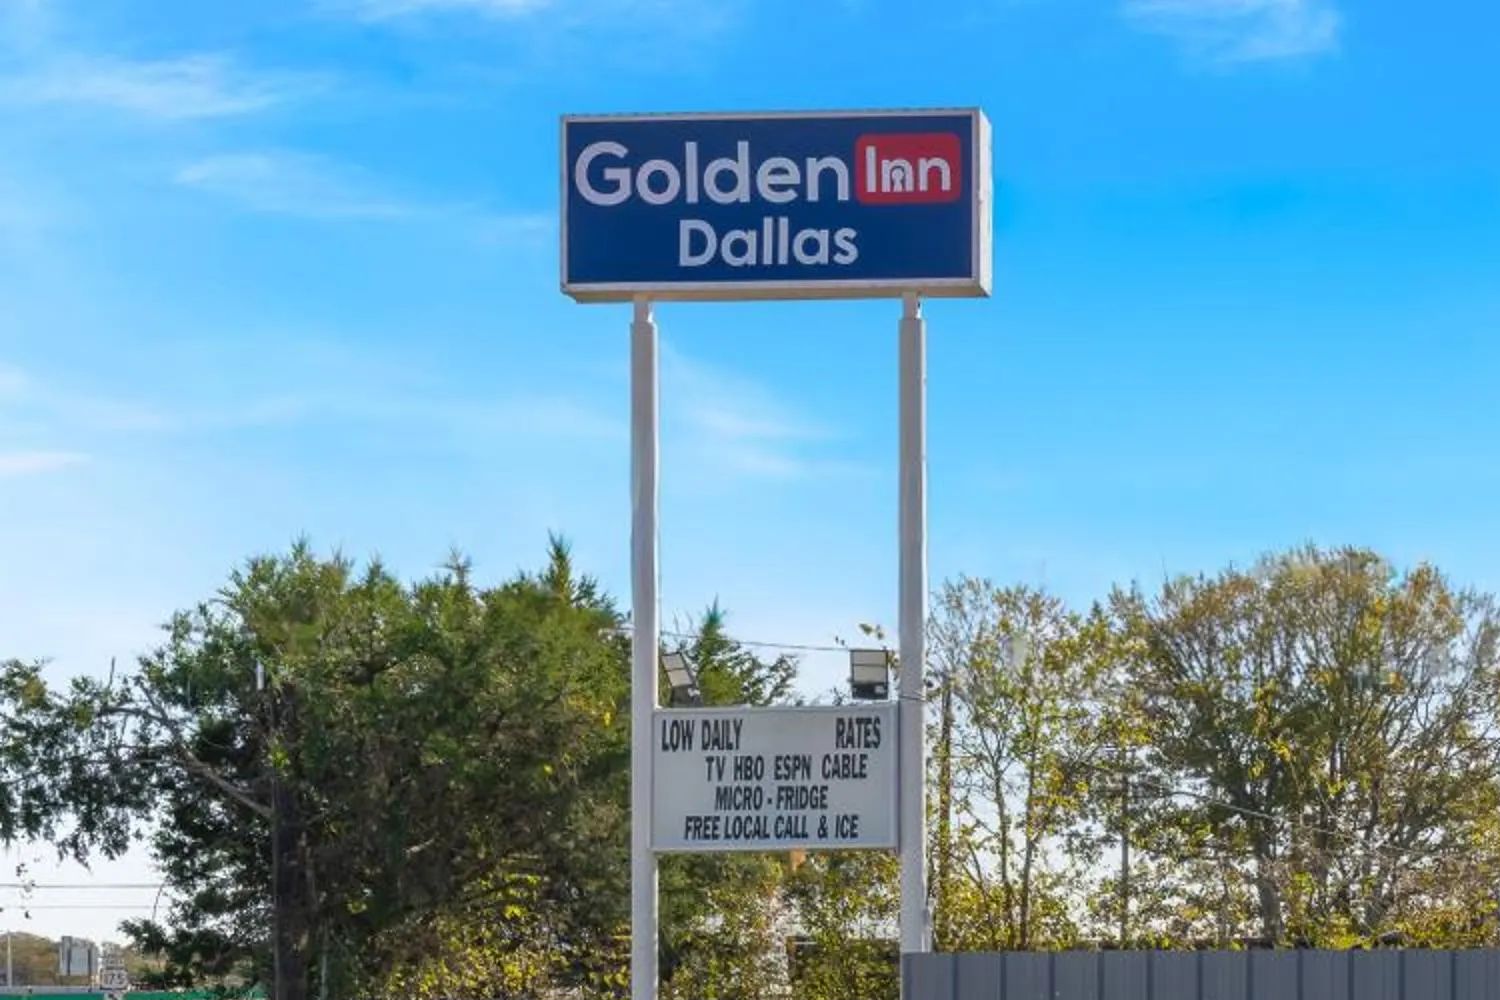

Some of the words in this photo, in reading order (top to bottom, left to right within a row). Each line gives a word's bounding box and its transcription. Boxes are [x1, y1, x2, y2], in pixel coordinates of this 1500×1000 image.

[575, 140, 849, 206] Golden
[865, 145, 951, 193] Inn
[679, 217, 859, 267] Dallas
[661, 719, 695, 751] LOW
[701, 718, 743, 750] DAILY
[835, 716, 881, 749] RATES
[705, 756, 727, 781] TV
[733, 755, 765, 781] HBO
[773, 755, 812, 780] ESPN
[821, 754, 868, 779] CABLE
[684, 815, 720, 841] FREE
[723, 815, 770, 840] LOCAL
[773, 815, 809, 839] CALL
[817, 816, 829, 838] &
[835, 814, 859, 838] ICE
